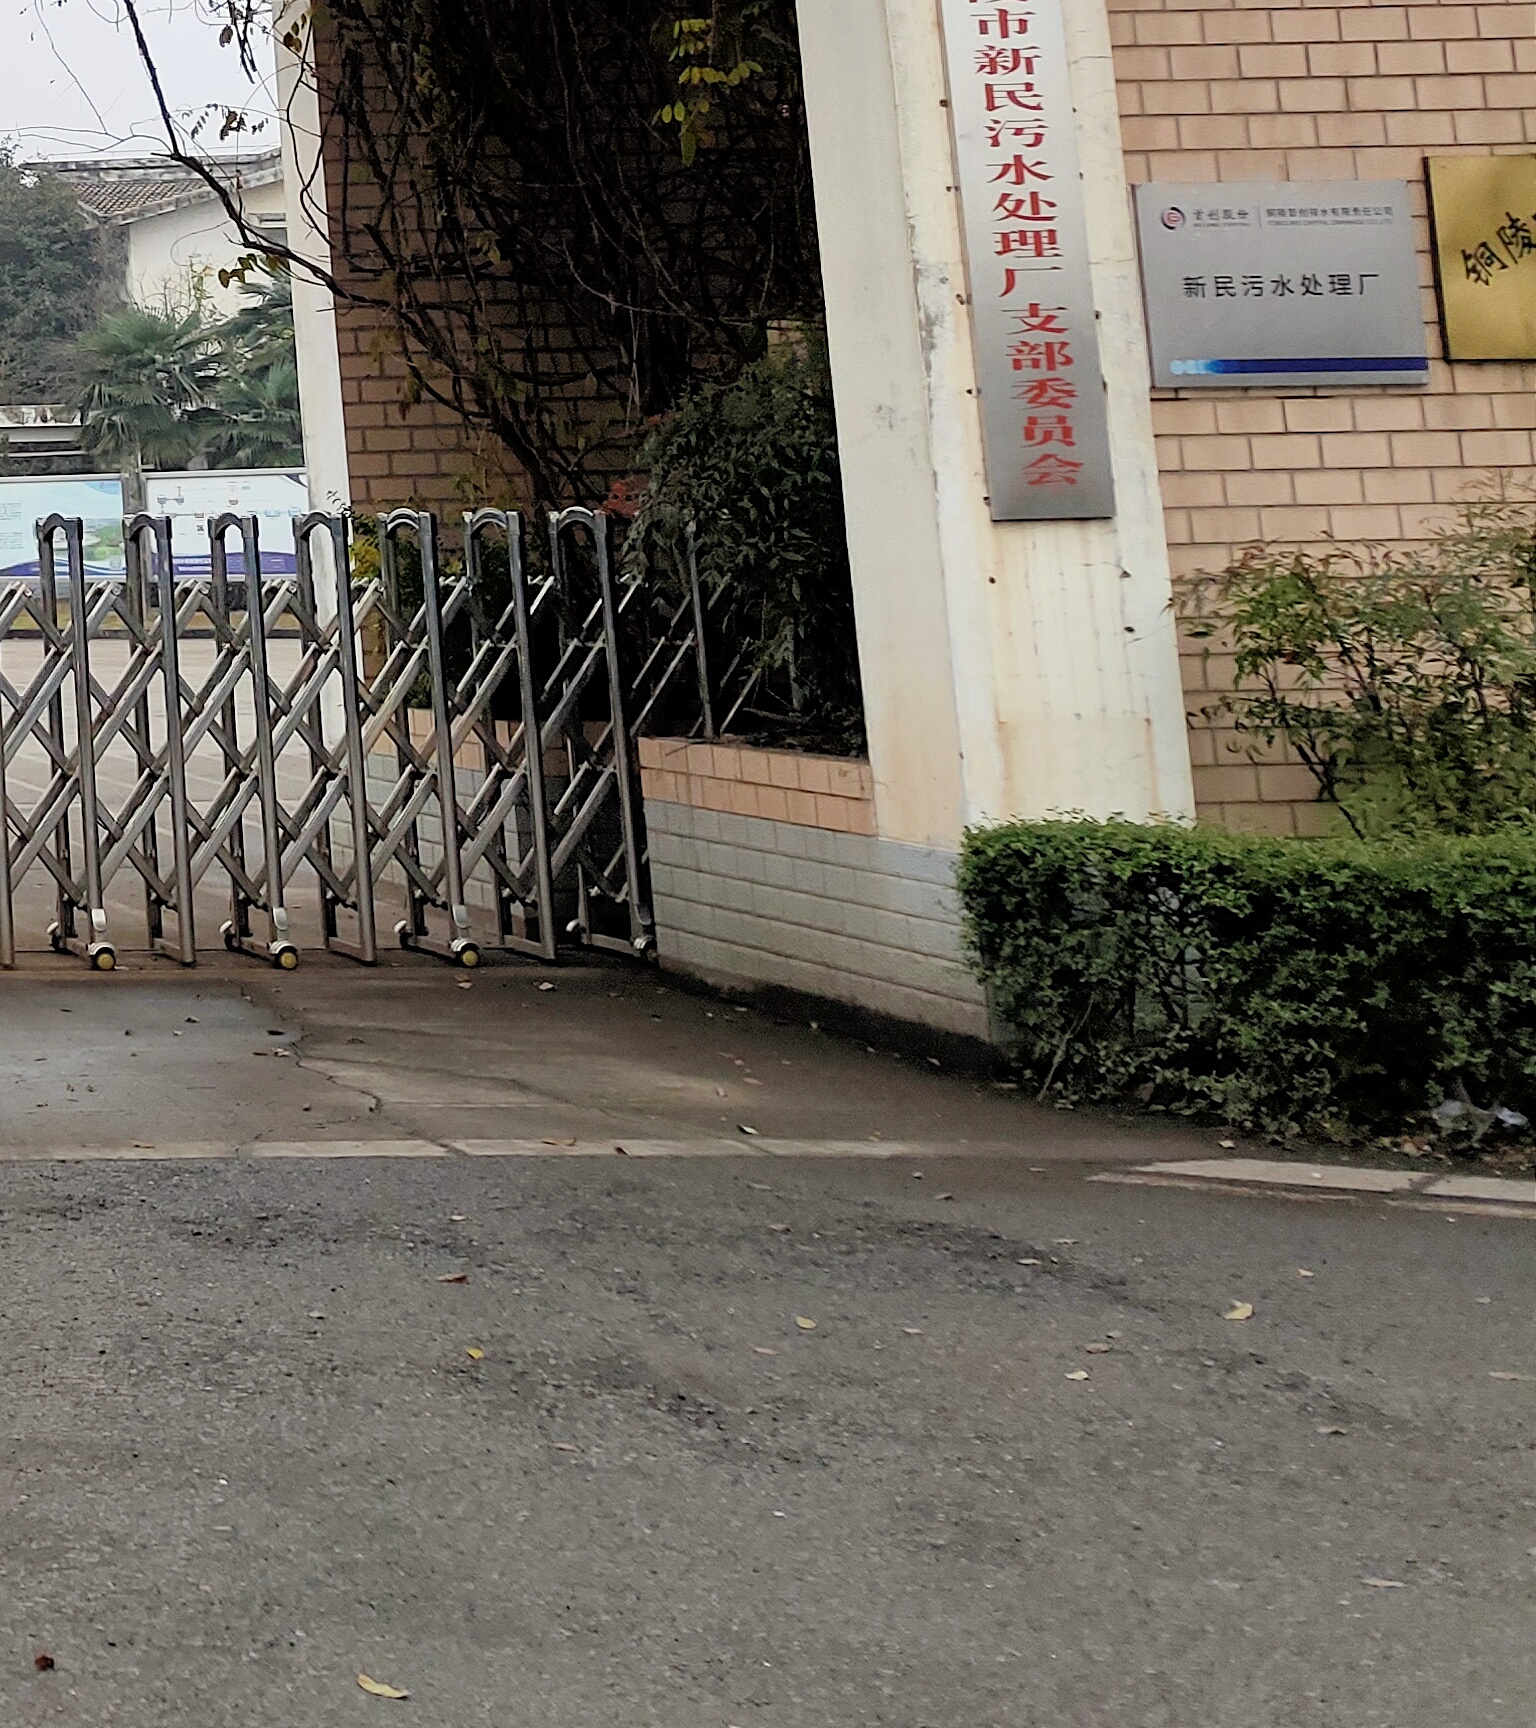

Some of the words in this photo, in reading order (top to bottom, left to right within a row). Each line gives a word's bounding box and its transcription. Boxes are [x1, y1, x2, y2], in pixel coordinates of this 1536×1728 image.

[1460, 211, 1536, 286] 铜陵
[1182, 273, 1379, 298] 新民污水处理厂
